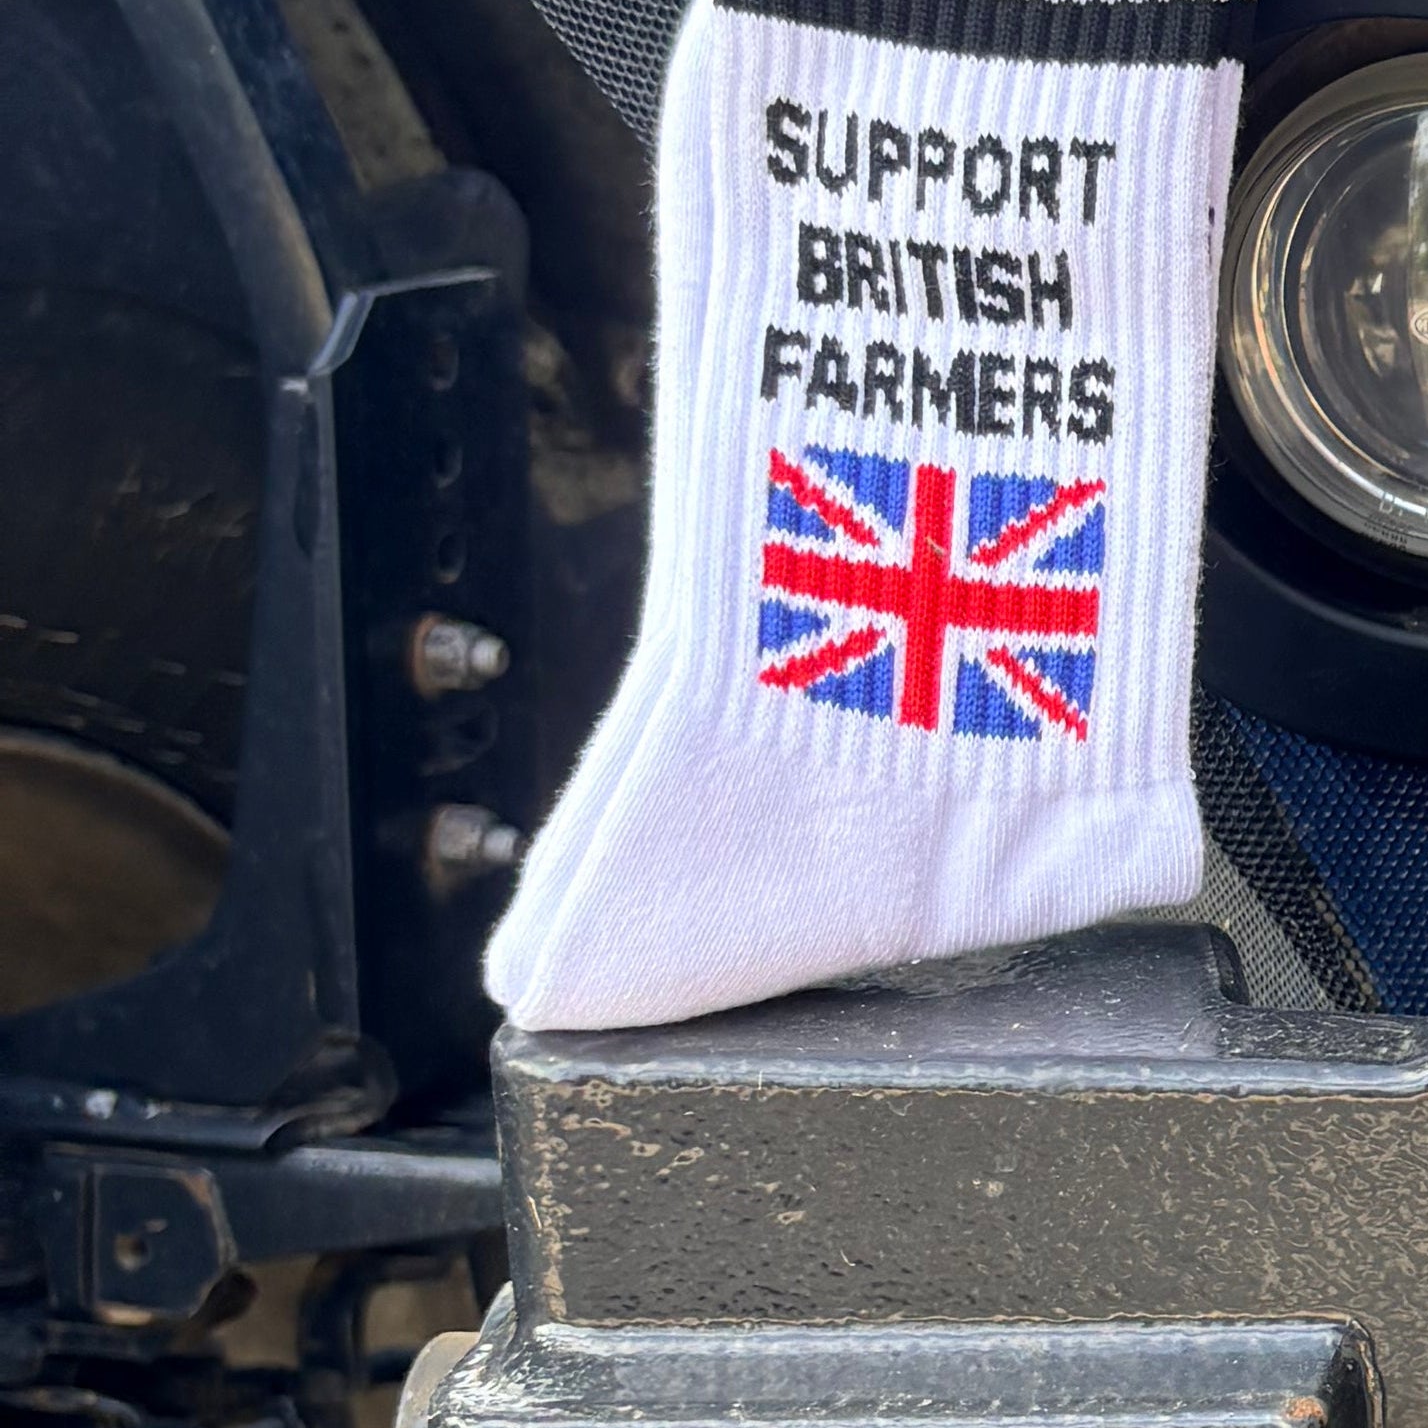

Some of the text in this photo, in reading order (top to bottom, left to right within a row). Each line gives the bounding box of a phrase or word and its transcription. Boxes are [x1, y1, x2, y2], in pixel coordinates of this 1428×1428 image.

[765, 96, 1116, 226] SUPPORT
[797, 220, 1073, 331] BRITISH
[760, 324, 1115, 445] FARMERS
